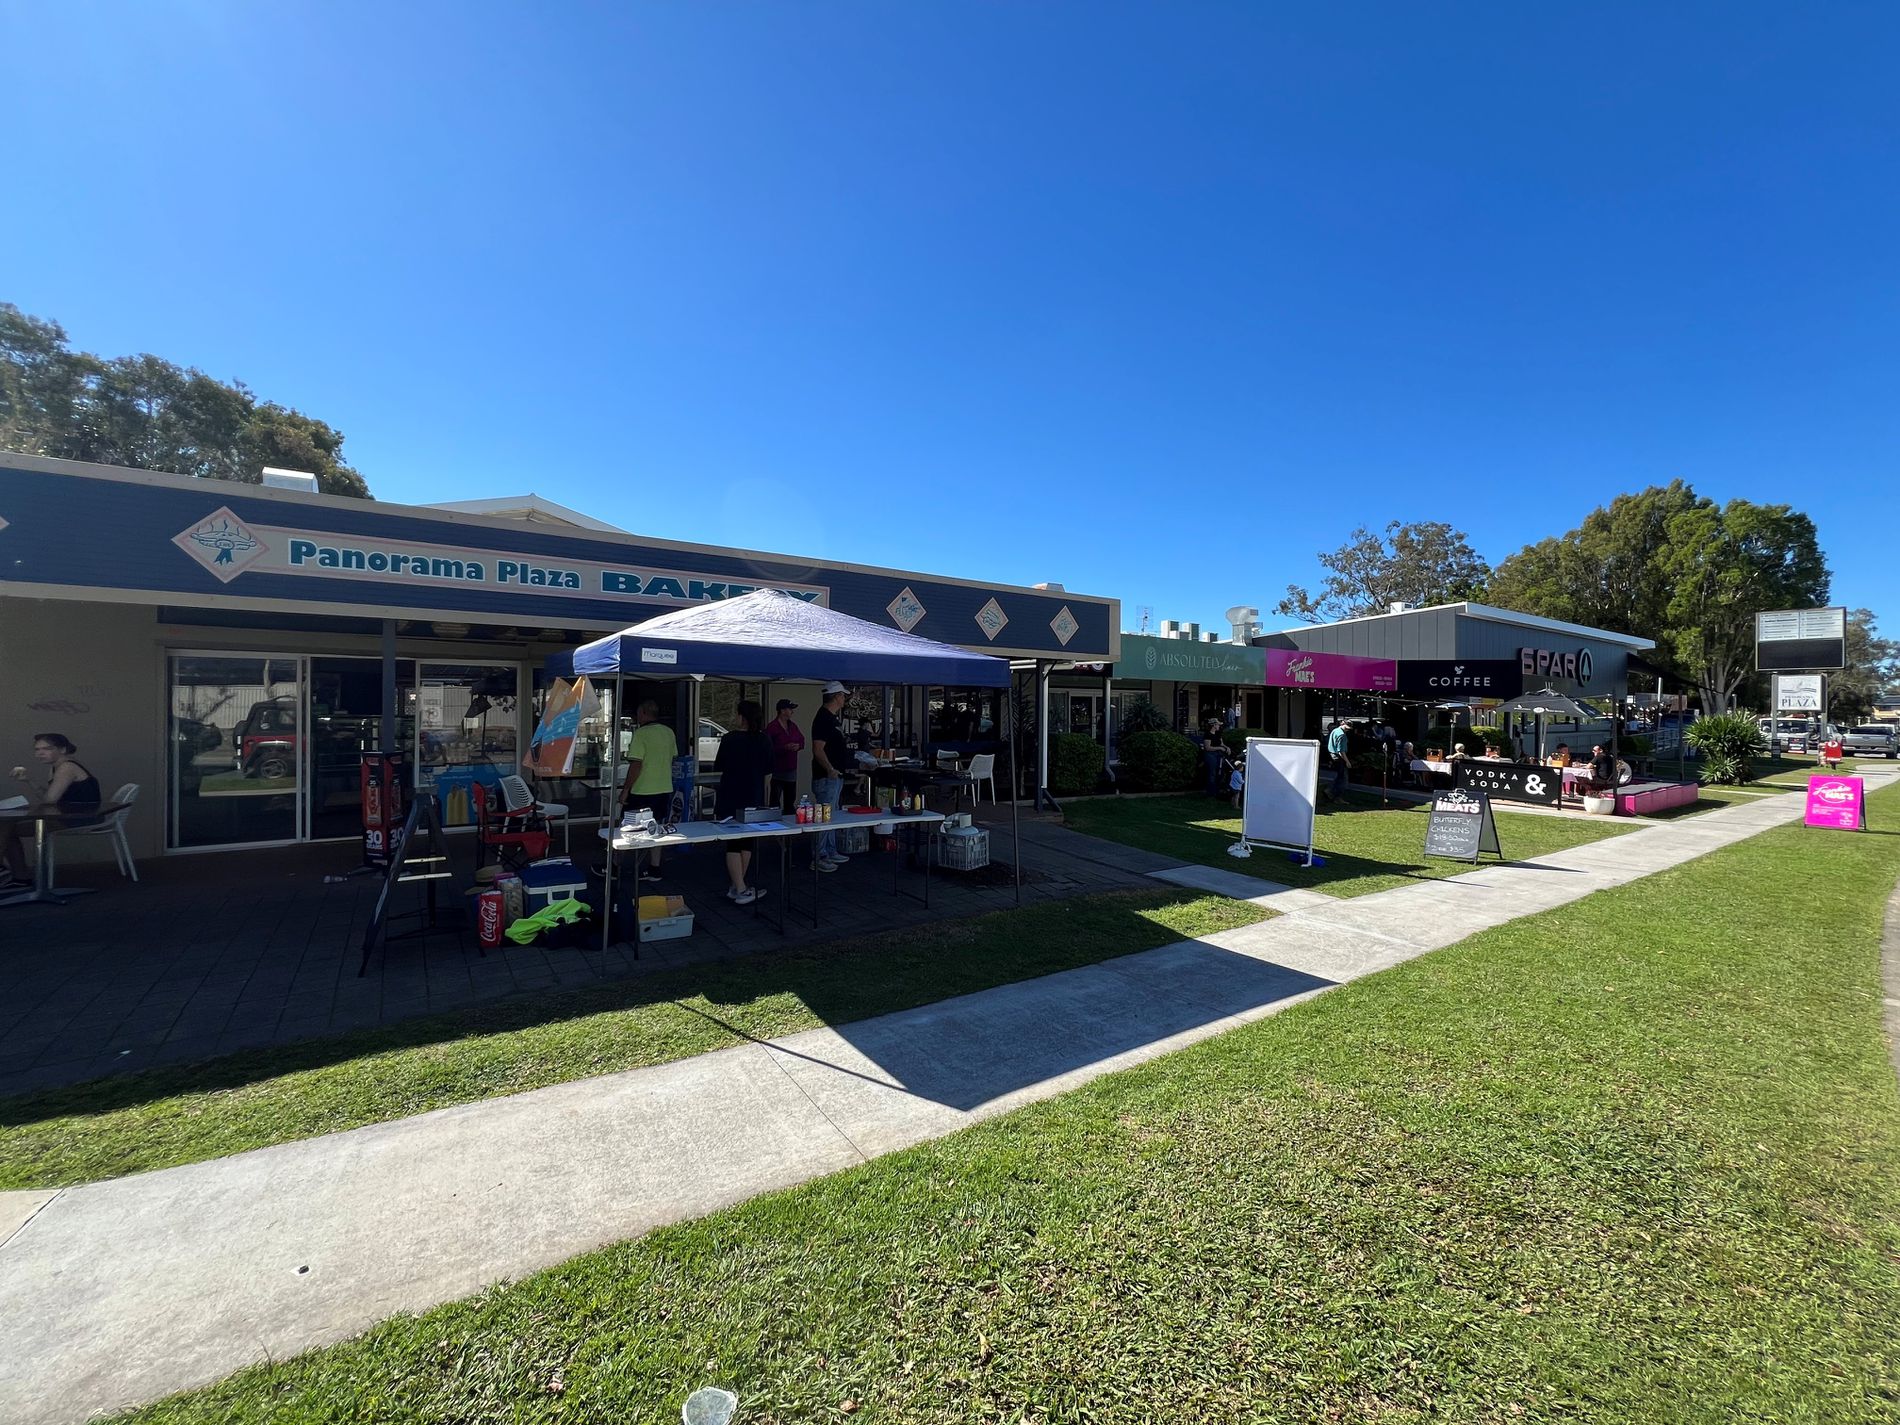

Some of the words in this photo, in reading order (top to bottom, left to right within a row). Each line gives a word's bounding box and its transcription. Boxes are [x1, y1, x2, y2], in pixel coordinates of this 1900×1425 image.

[288, 538, 485, 581] Panorama
[496, 559, 581, 590] Plaza
[600, 570, 821, 604] BAKY
[1160, 653, 1221, 669] ABSOLUTELY
[1521, 647, 1577, 679] SPAR
[1429, 676, 1491, 687] COFFEE
[1781, 698, 1817, 707] PLAZA
[1465, 768, 1519, 781] VODKA
[1470, 779, 1511, 791] SODA
[1435, 800, 1481, 814] MEATS
[366, 829, 383, 844] 30
